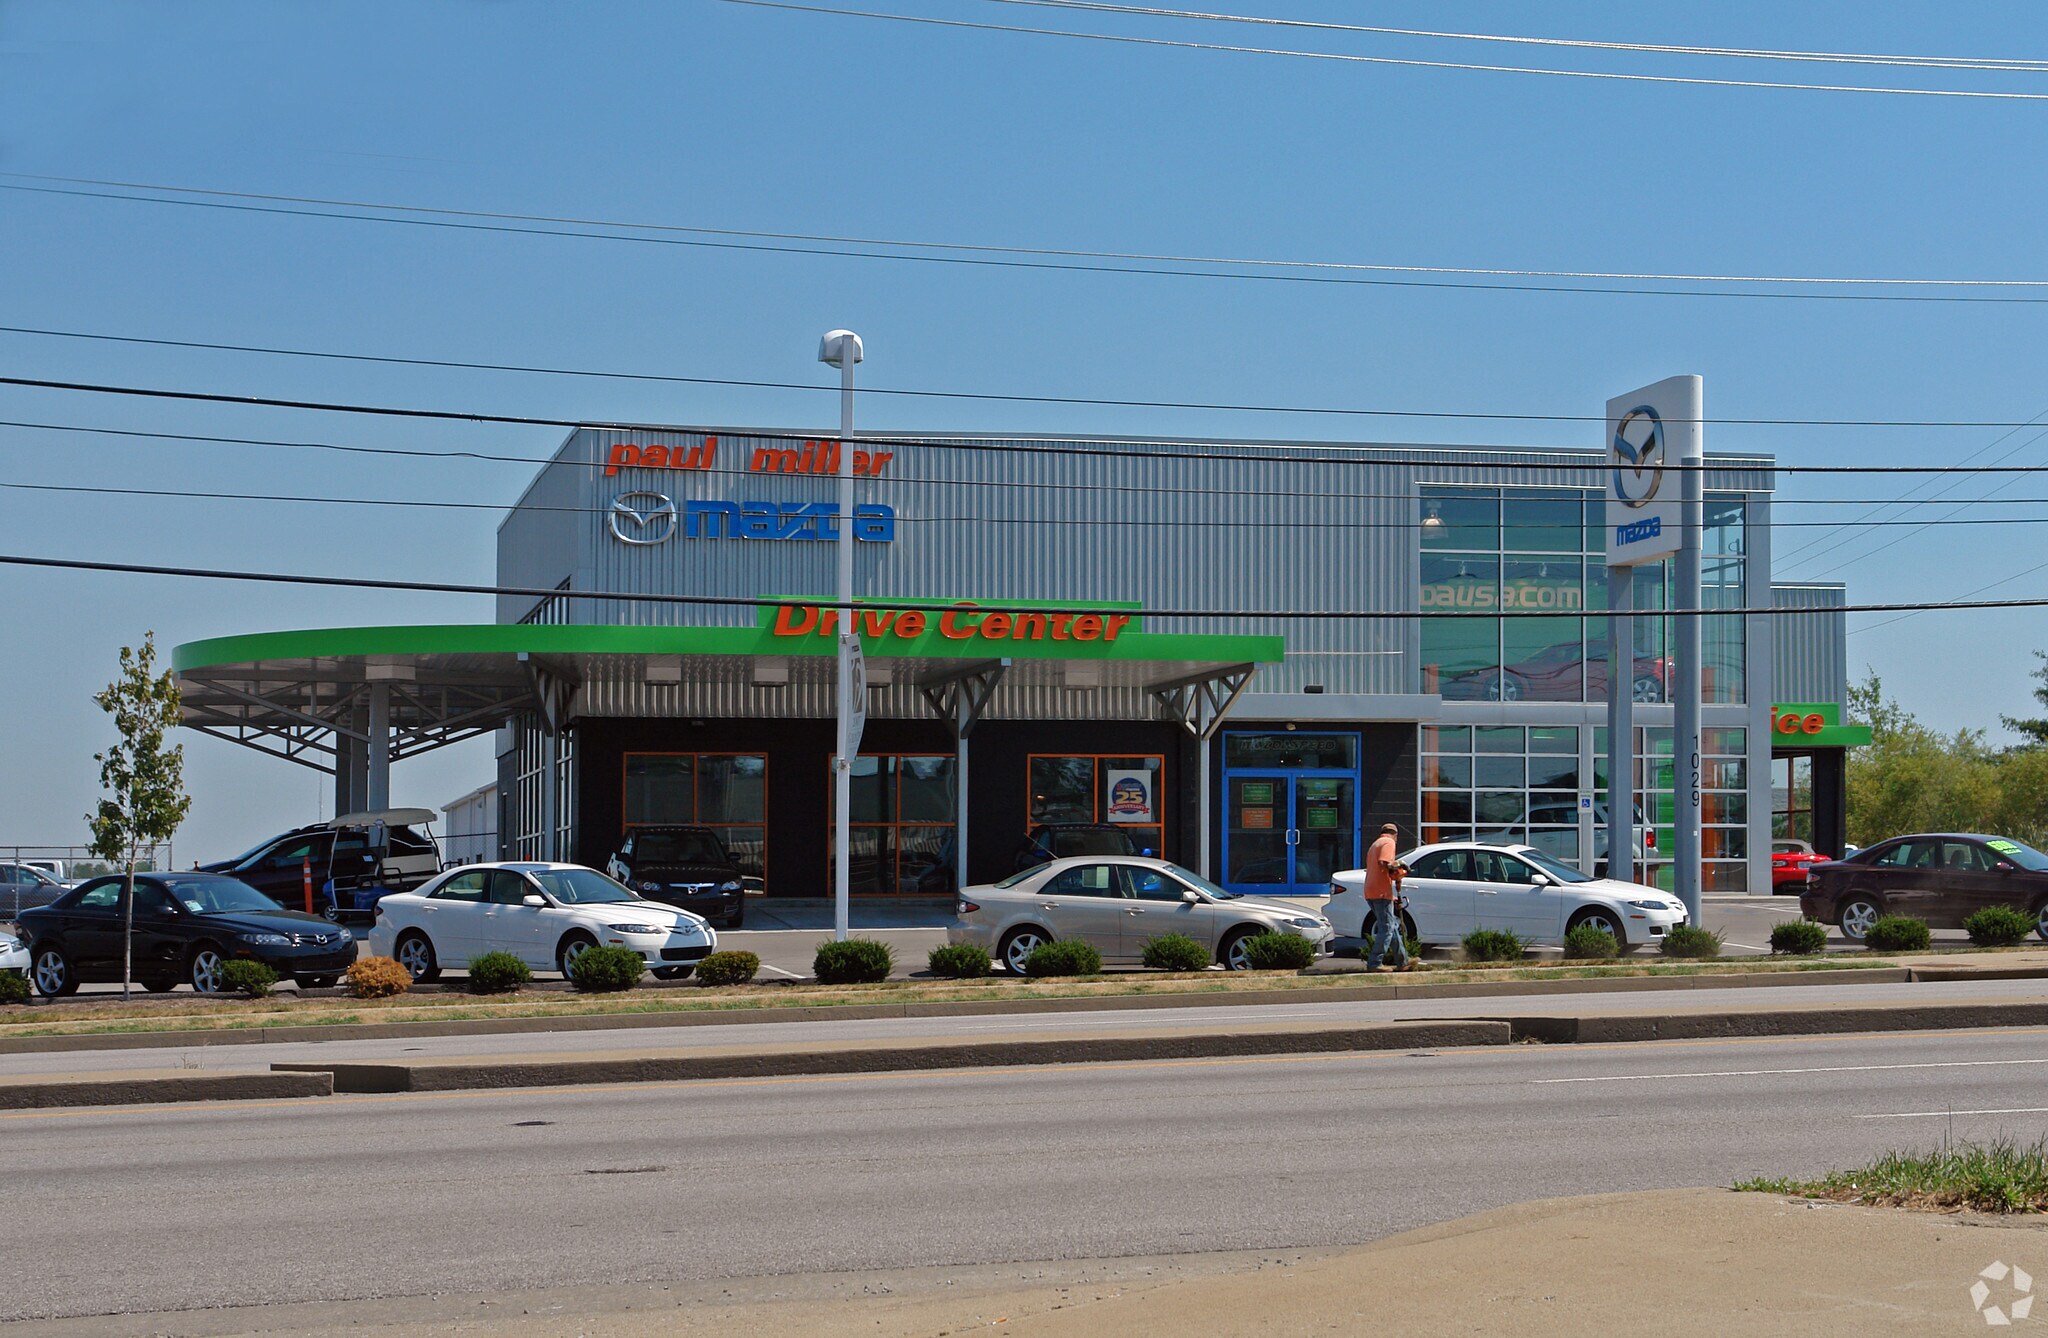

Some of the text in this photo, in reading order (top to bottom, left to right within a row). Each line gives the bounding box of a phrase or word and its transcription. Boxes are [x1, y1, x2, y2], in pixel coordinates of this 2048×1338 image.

[605, 436, 893, 476] paul miller
[939, 601, 1131, 641] Center
[1691, 734, 1700, 807] 1029
[1115, 791, 1144, 804] 25
